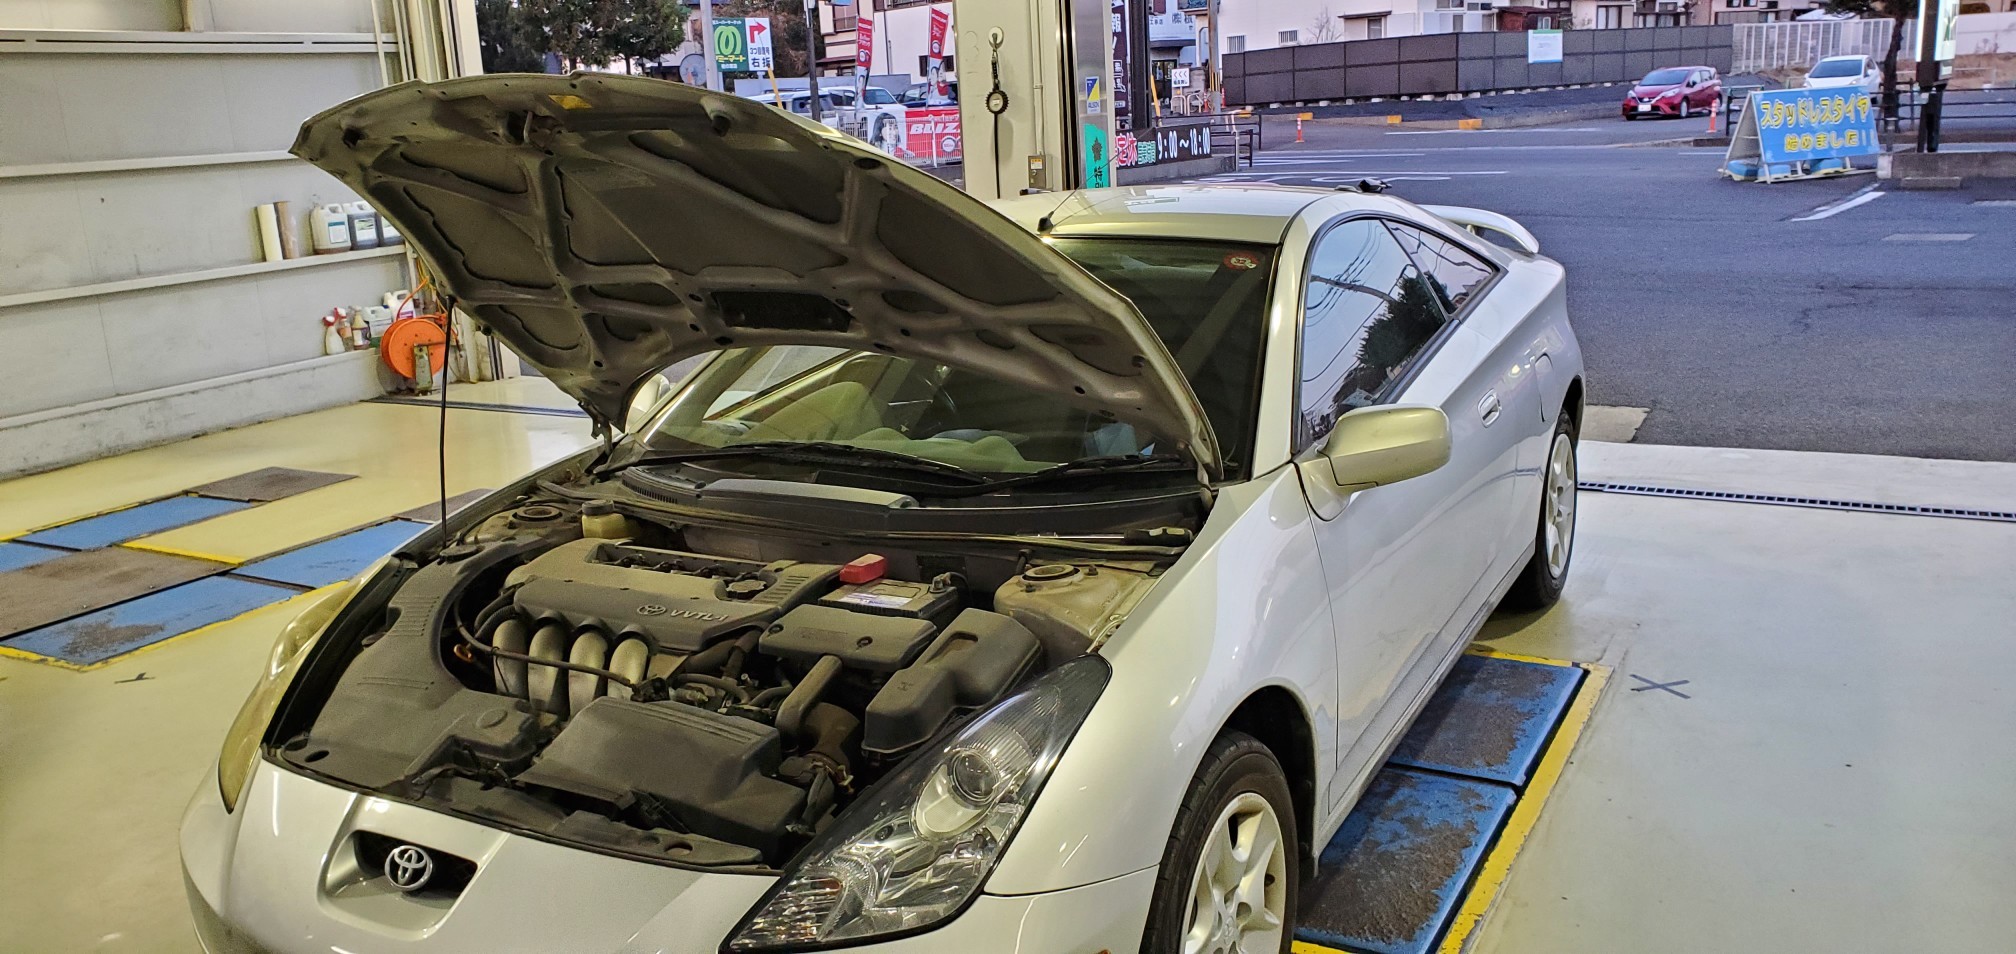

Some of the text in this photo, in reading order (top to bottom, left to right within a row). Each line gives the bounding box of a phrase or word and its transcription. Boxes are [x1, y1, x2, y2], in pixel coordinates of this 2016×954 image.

[1761, 94, 1870, 129] スタッドレスタイヤ
[910, 122, 961, 134] BLIZ
